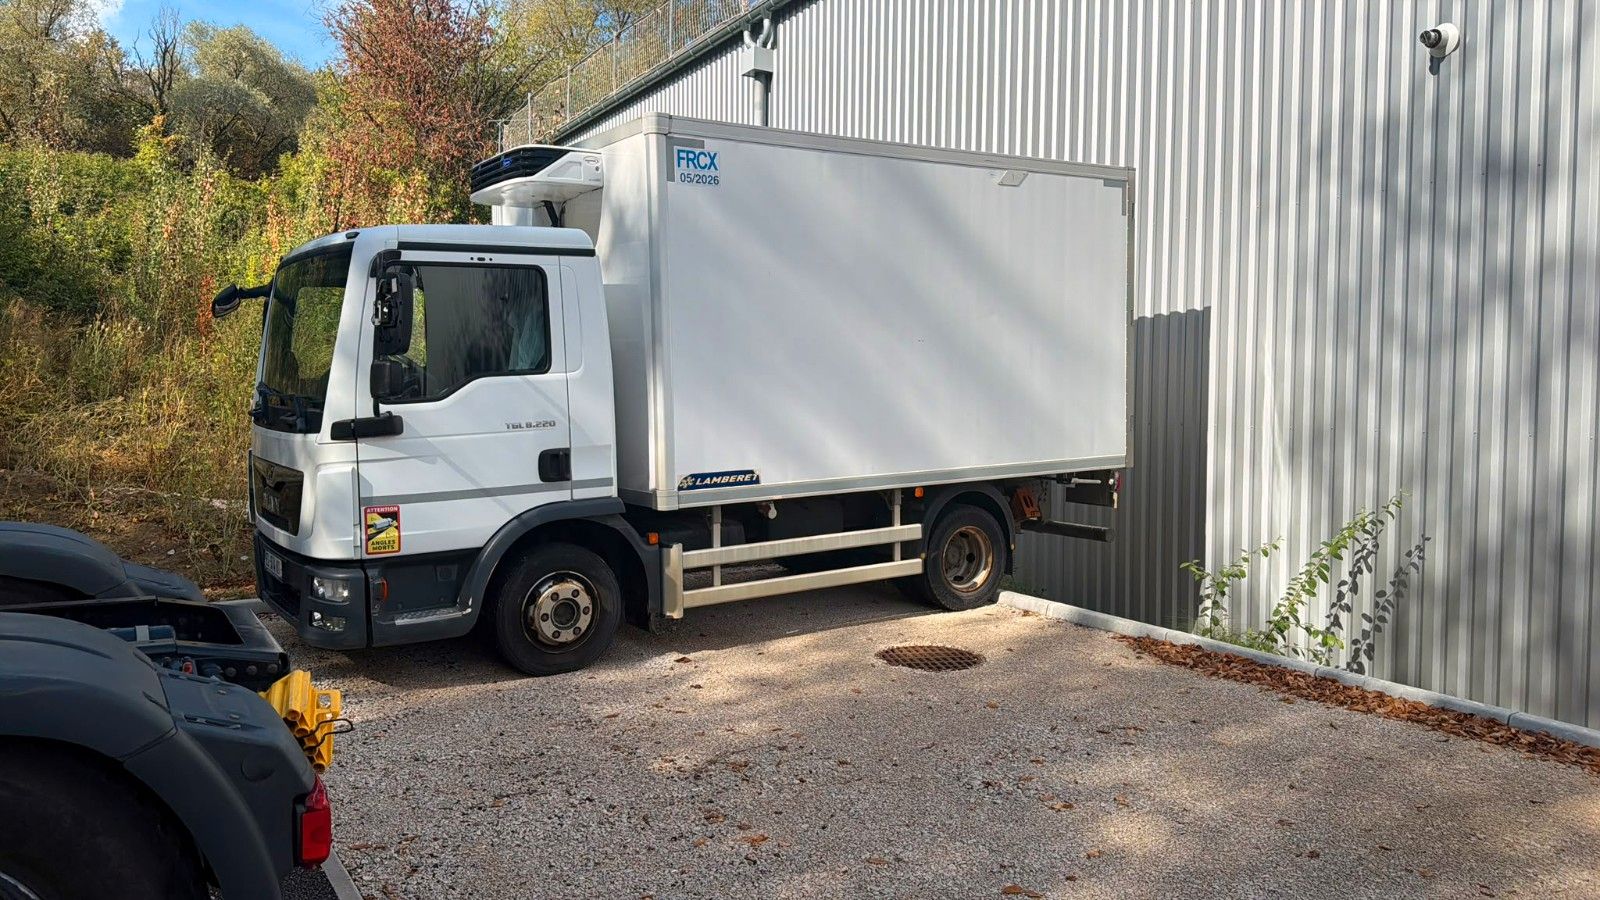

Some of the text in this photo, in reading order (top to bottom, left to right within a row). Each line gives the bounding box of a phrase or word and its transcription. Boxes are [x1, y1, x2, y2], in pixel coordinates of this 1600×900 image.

[677, 149, 719, 171] FRCX
[680, 172, 719, 185] 05/2026
[525, 420, 556, 429] 8.220
[695, 473, 757, 485] LAMBERET
